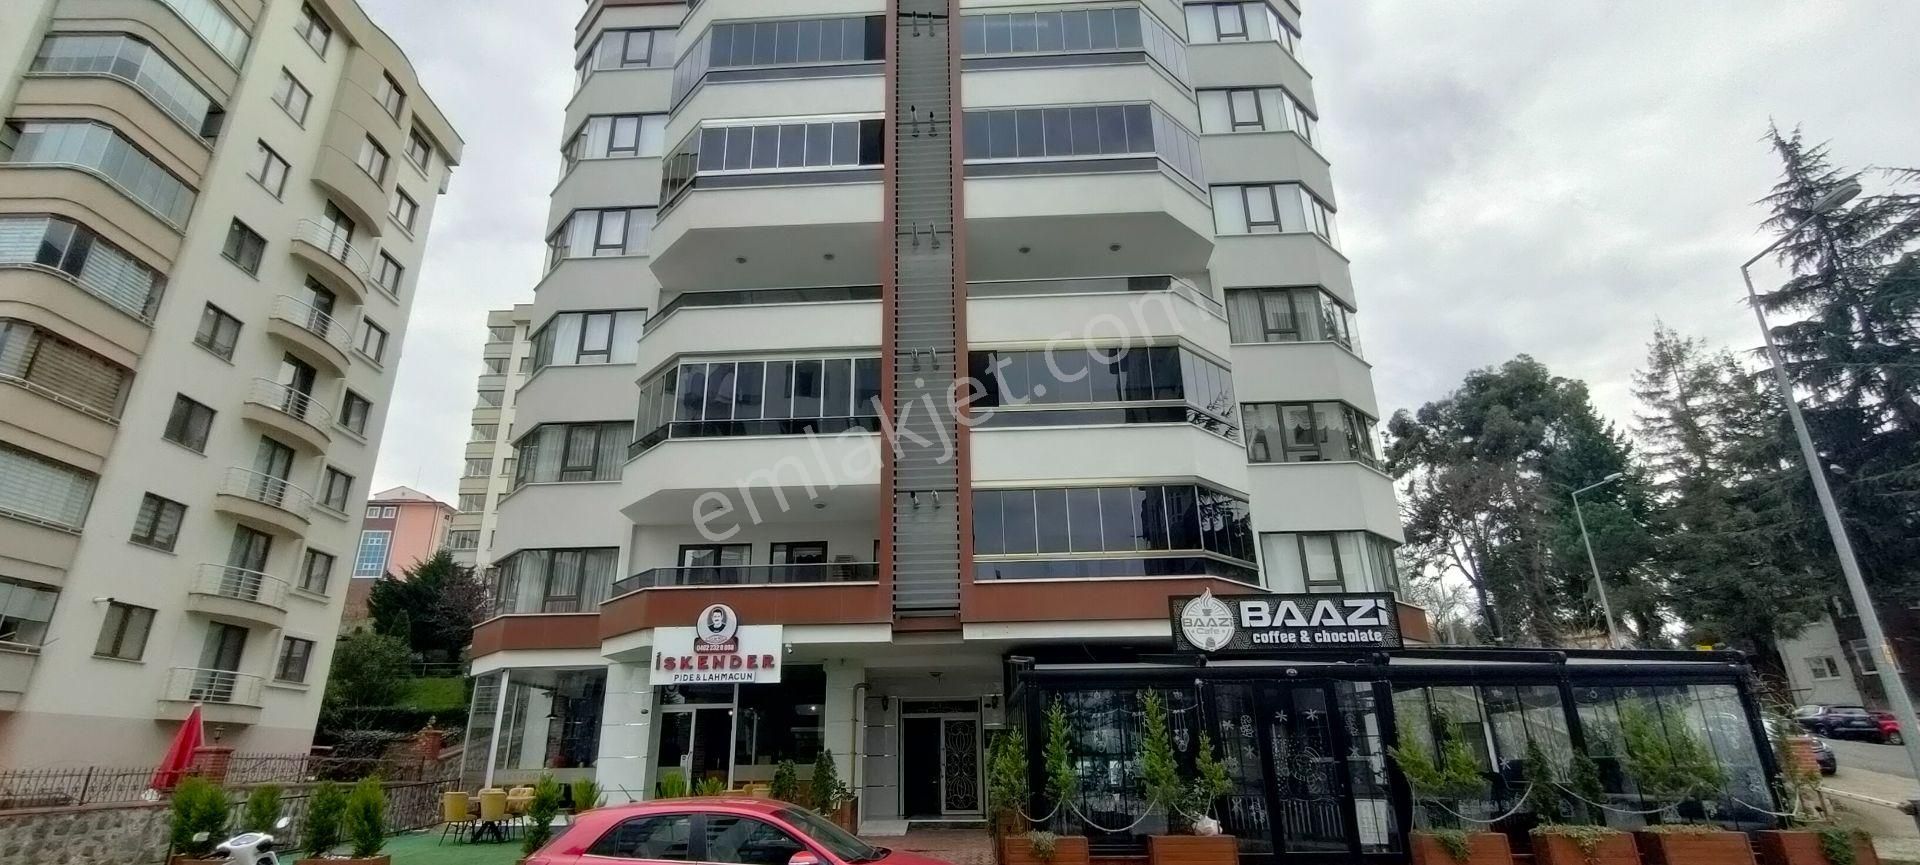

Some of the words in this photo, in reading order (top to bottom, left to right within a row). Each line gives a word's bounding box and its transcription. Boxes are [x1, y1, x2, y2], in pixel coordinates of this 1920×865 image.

[1252, 631, 1297, 643] coffee
[1299, 630, 1311, 642] &
[1314, 629, 1383, 643] chocolate
